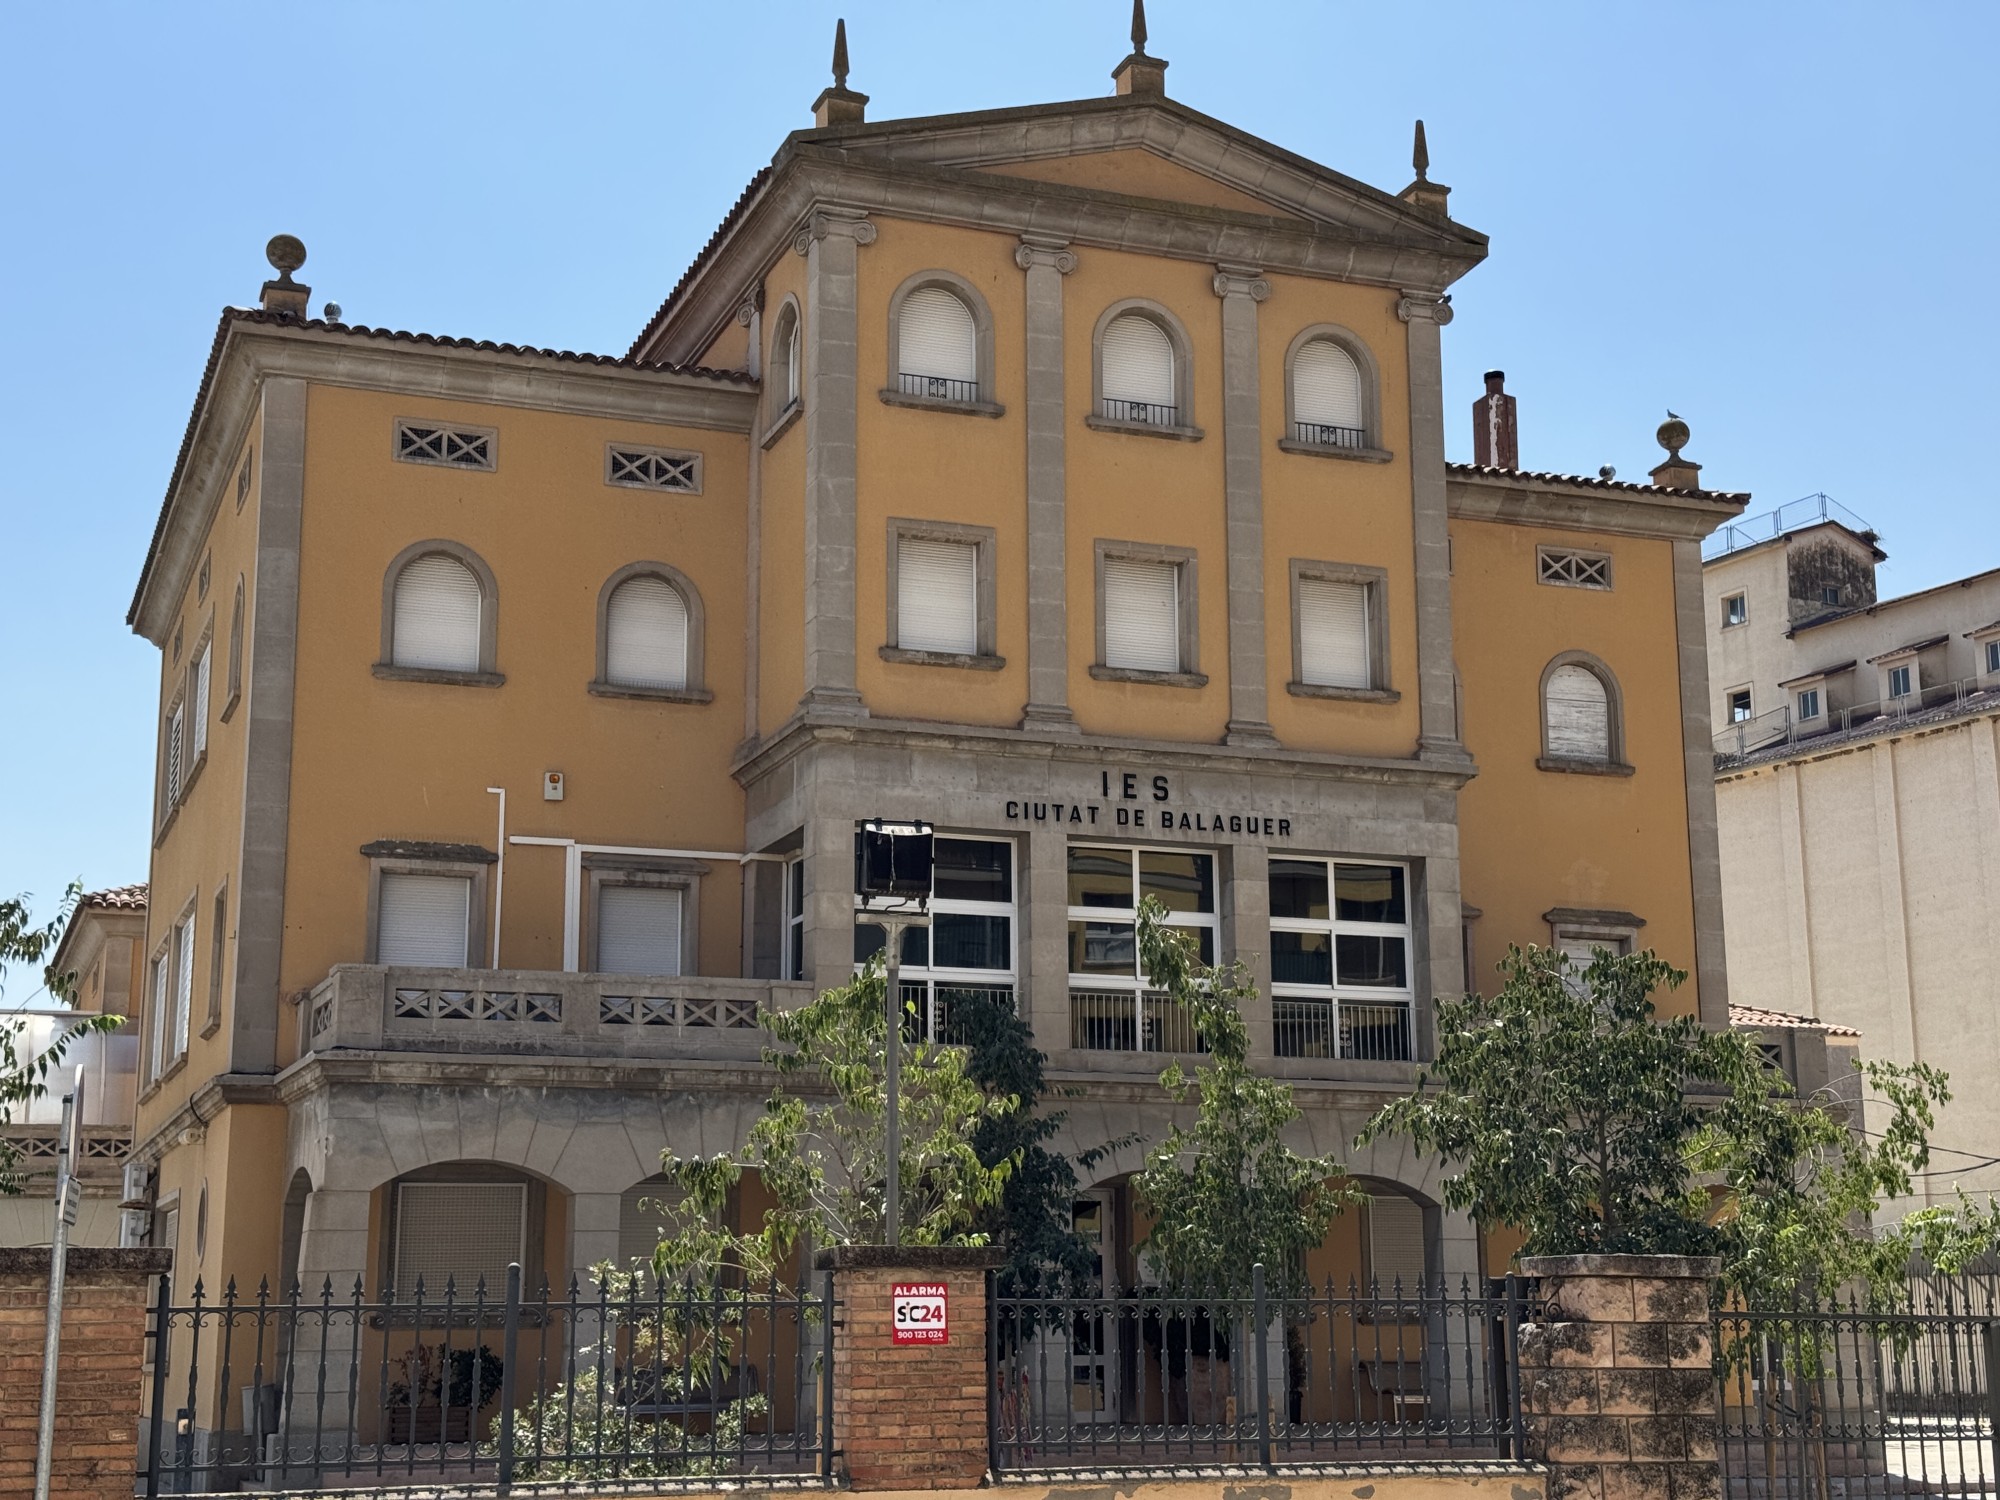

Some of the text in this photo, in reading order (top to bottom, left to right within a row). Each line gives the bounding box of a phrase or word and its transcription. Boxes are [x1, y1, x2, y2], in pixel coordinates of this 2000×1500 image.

[1102, 770, 1169, 801] IES
[1006, 801, 1291, 836] CIUTAT DE BALAGUER
[894, 1286, 945, 1296] ALARMA
